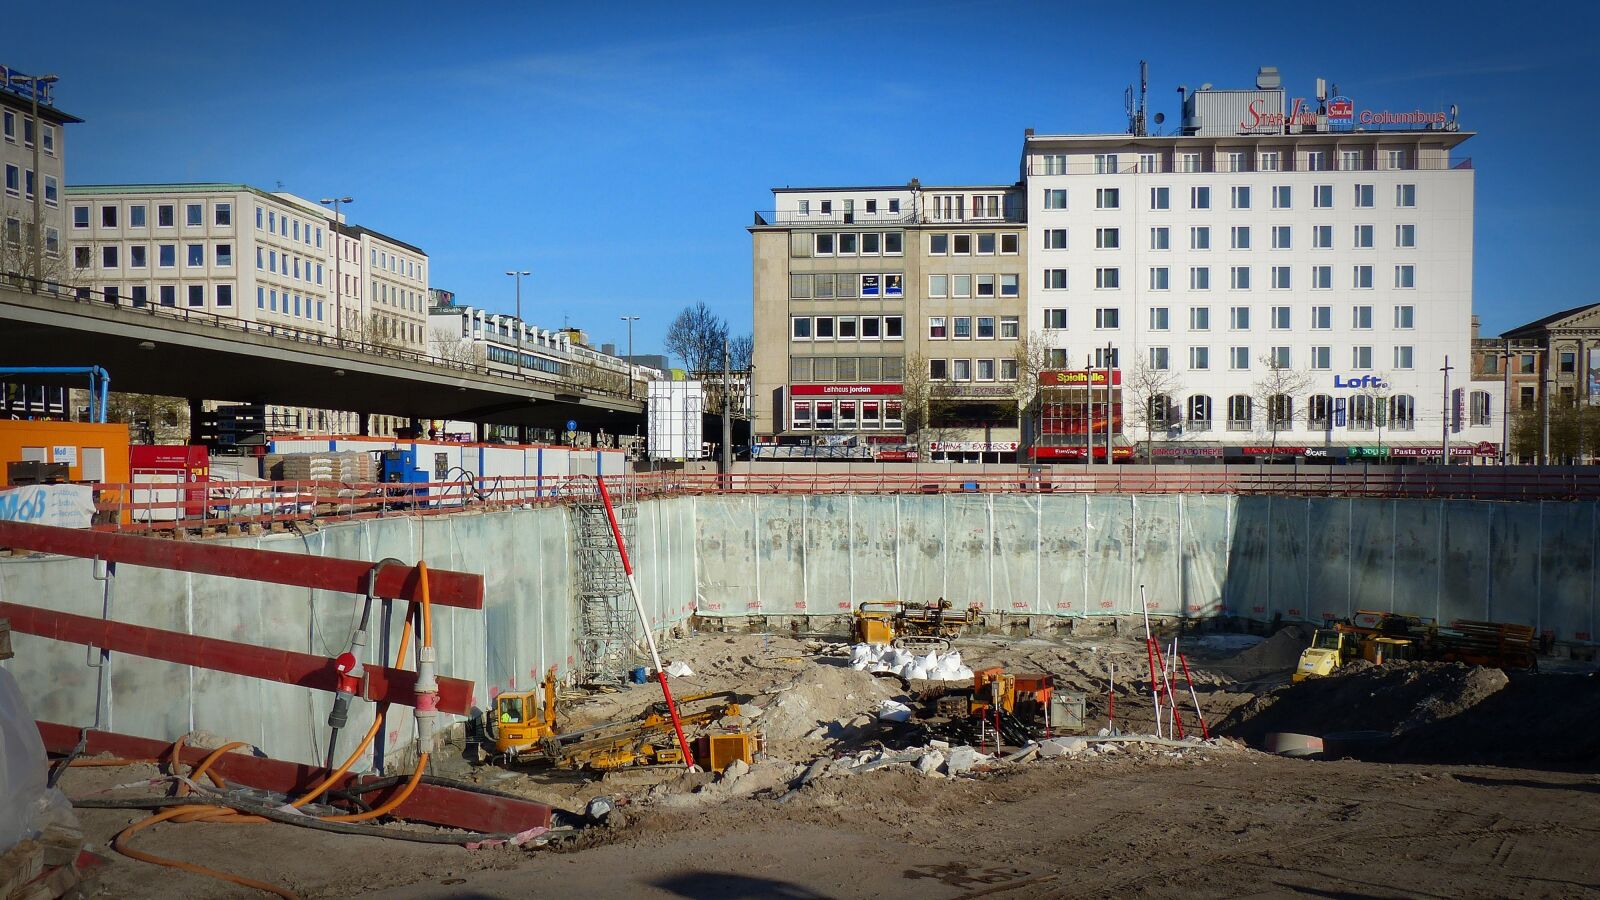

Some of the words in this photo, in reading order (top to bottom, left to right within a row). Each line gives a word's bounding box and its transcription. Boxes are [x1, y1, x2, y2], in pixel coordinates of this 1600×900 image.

[1360, 110, 1446, 124] Columbus
[1057, 373, 1104, 383] Spielhlle
[1421, 448, 1443, 456] Gyros
